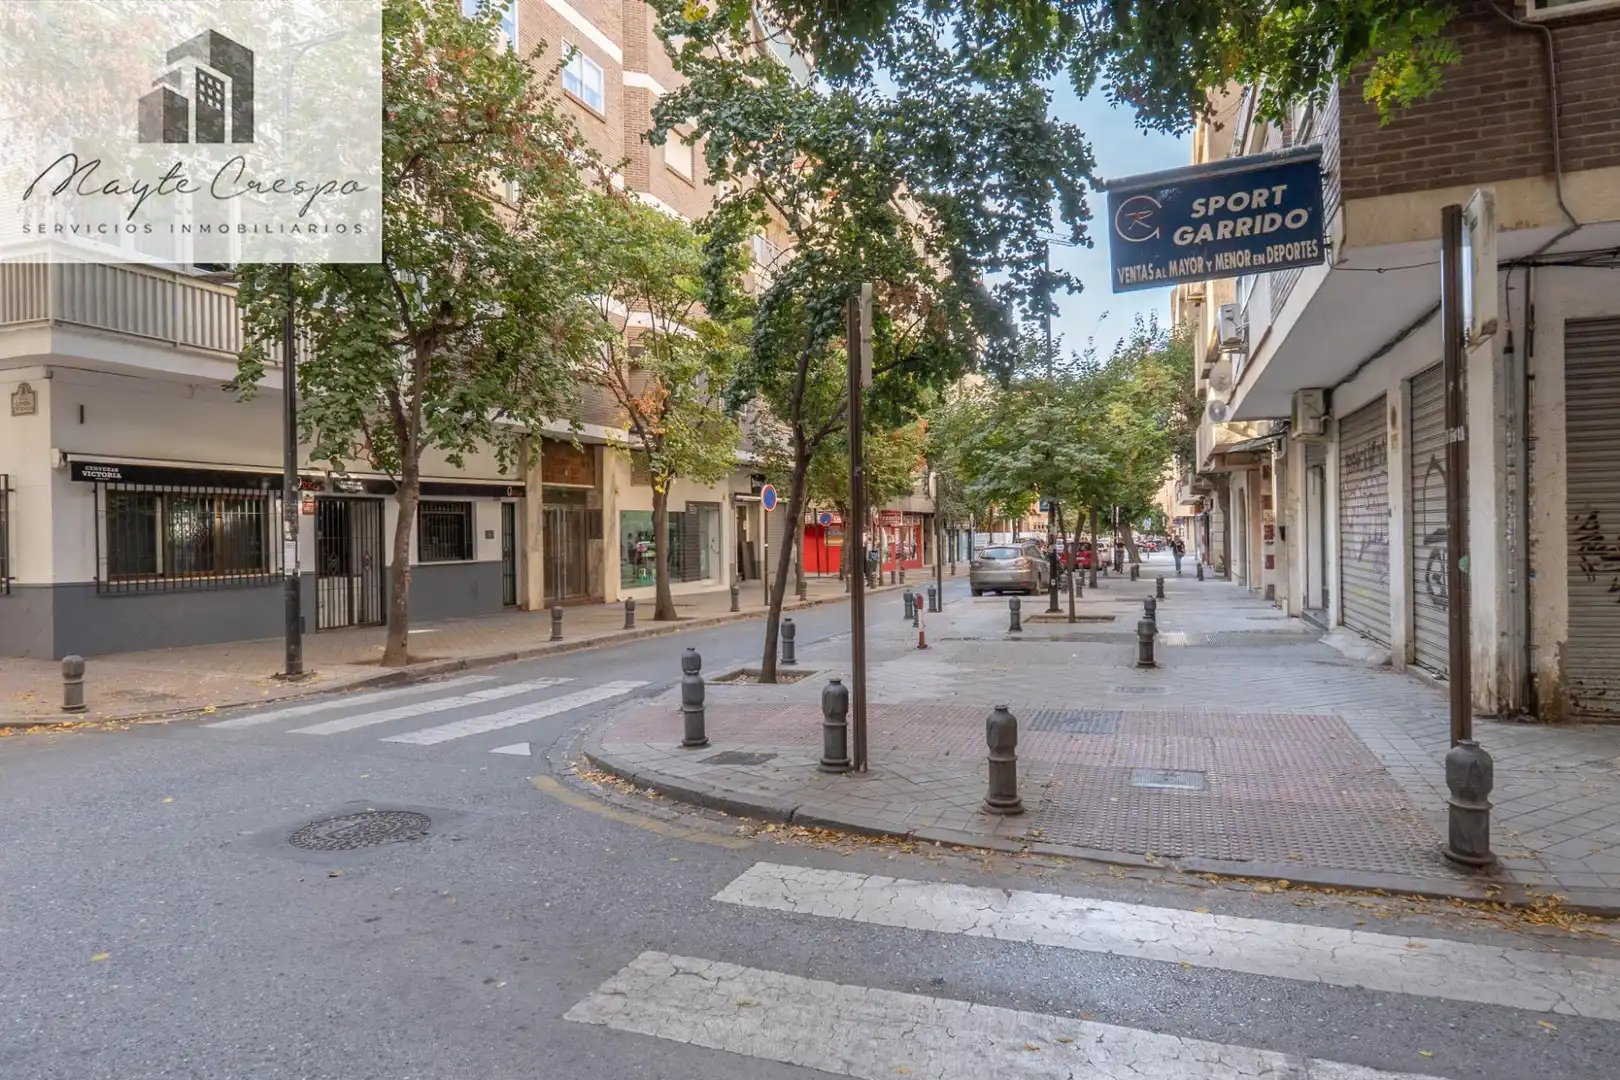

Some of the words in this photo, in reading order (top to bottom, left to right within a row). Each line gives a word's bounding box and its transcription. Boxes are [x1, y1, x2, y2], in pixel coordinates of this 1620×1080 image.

[1190, 184, 1288, 219] SPORT
[1173, 208, 1309, 246] GARRIDO
[1117, 264, 1154, 285] VENTAS
[1155, 269, 1168, 279] AL
[1169, 256, 1204, 277] MAYOR
[1207, 261, 1213, 271] Y
[1215, 251, 1251, 272] MENOR
[1253, 254, 1266, 265] EN
[1266, 239, 1319, 264] DEPORTES
[81, 470, 122, 479] VICTORIA
